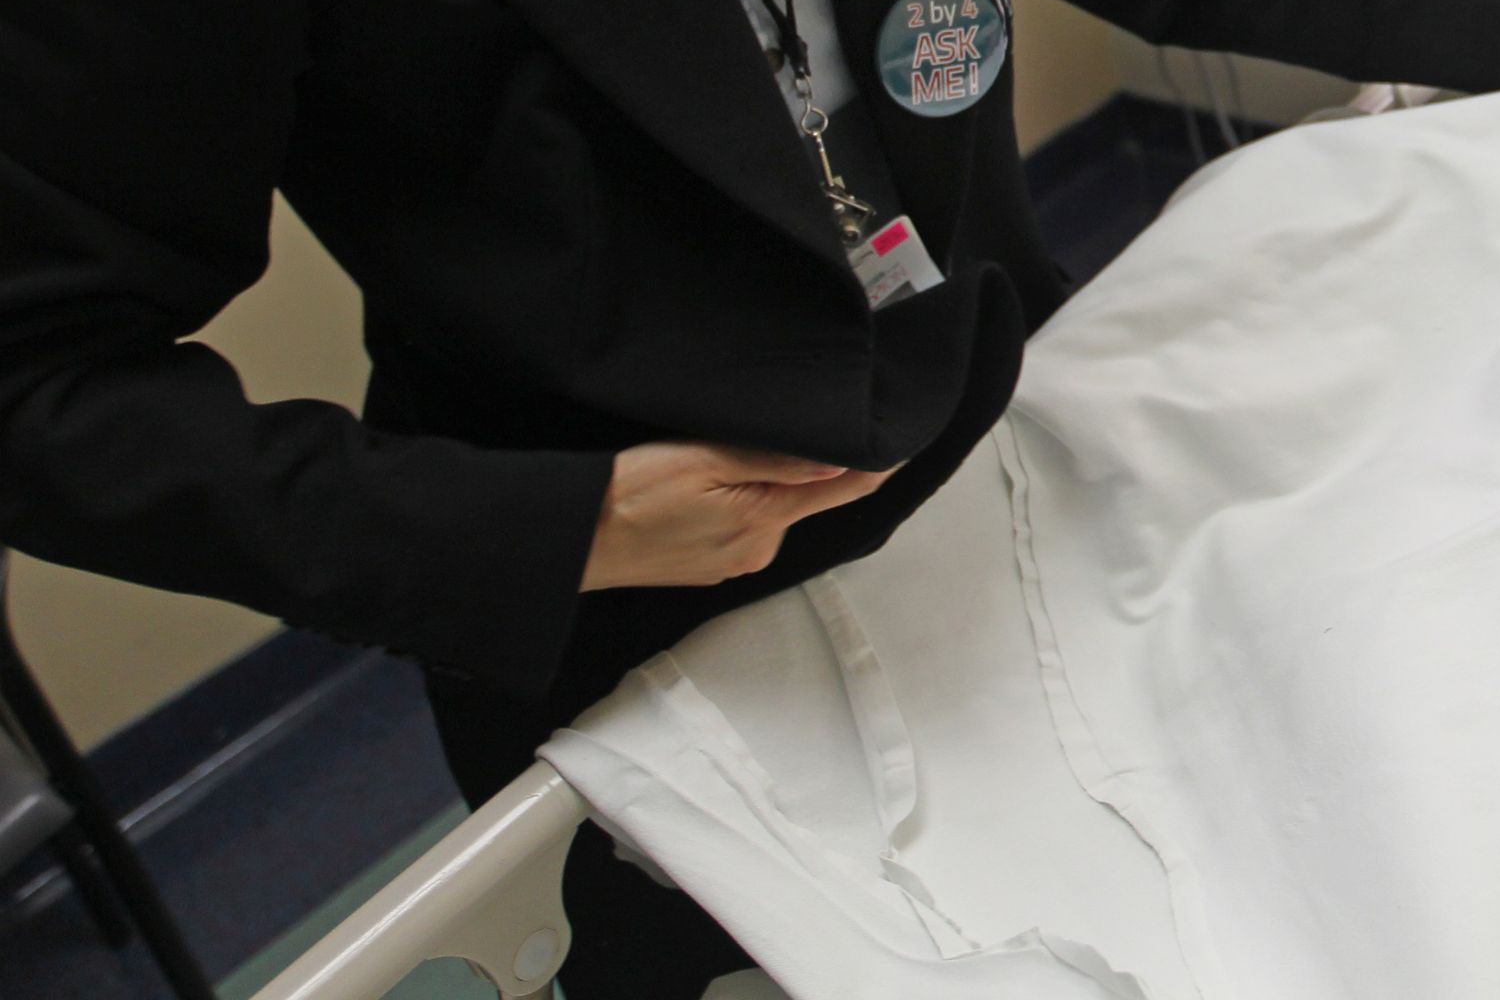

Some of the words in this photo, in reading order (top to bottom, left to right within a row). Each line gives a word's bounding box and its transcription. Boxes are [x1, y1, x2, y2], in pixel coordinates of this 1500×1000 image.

[906, 3, 925, 28] 2
[930, 0, 957, 27] by
[912, 24, 982, 69] ASK
[911, 62, 979, 105] ME!
